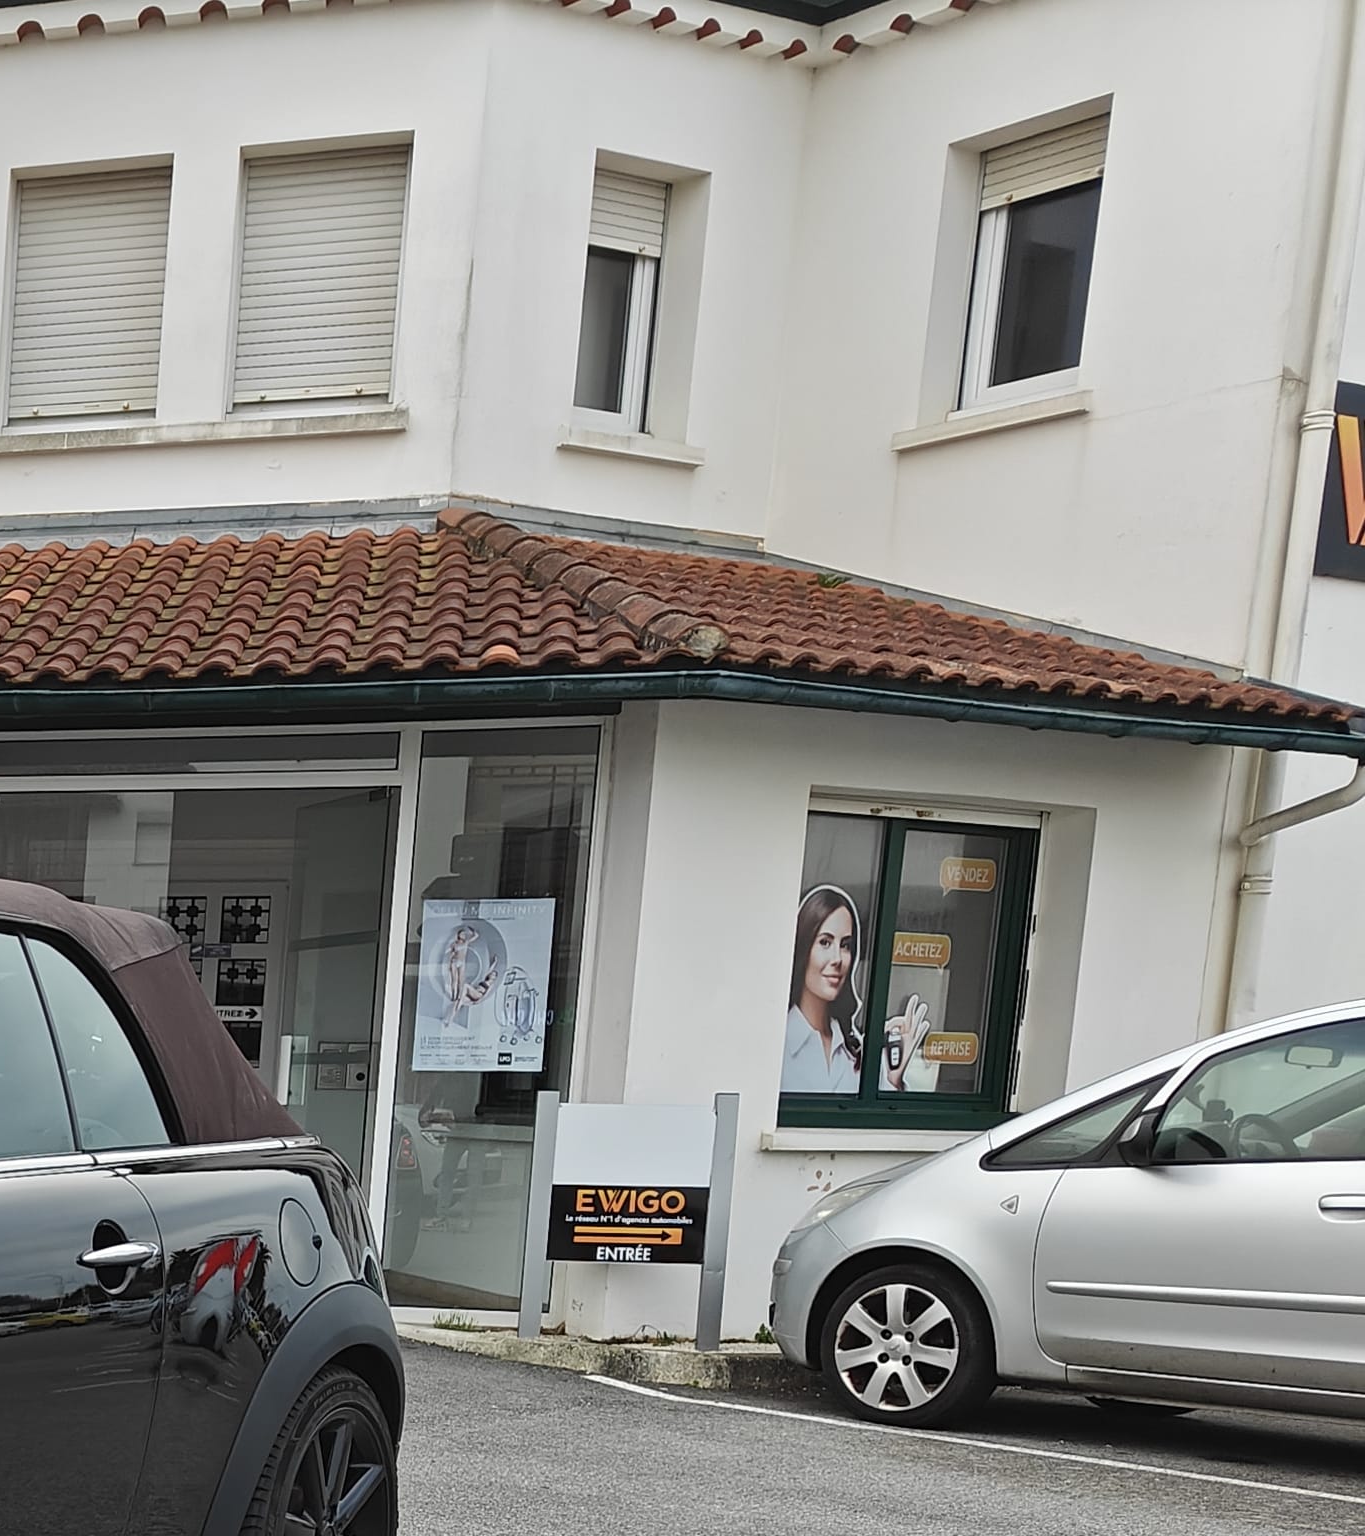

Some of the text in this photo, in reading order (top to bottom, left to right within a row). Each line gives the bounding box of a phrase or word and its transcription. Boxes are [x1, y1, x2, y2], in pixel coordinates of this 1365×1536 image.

[947, 866, 989, 884] VENDEZ
[894, 939, 942, 958] ACHETEZ
[930, 1040, 971, 1057] REPRISE
[575, 1189, 686, 1214] EWIGO
[651, 1216, 693, 1225] automobiles
[596, 1244, 652, 1261] ENTRÉE
